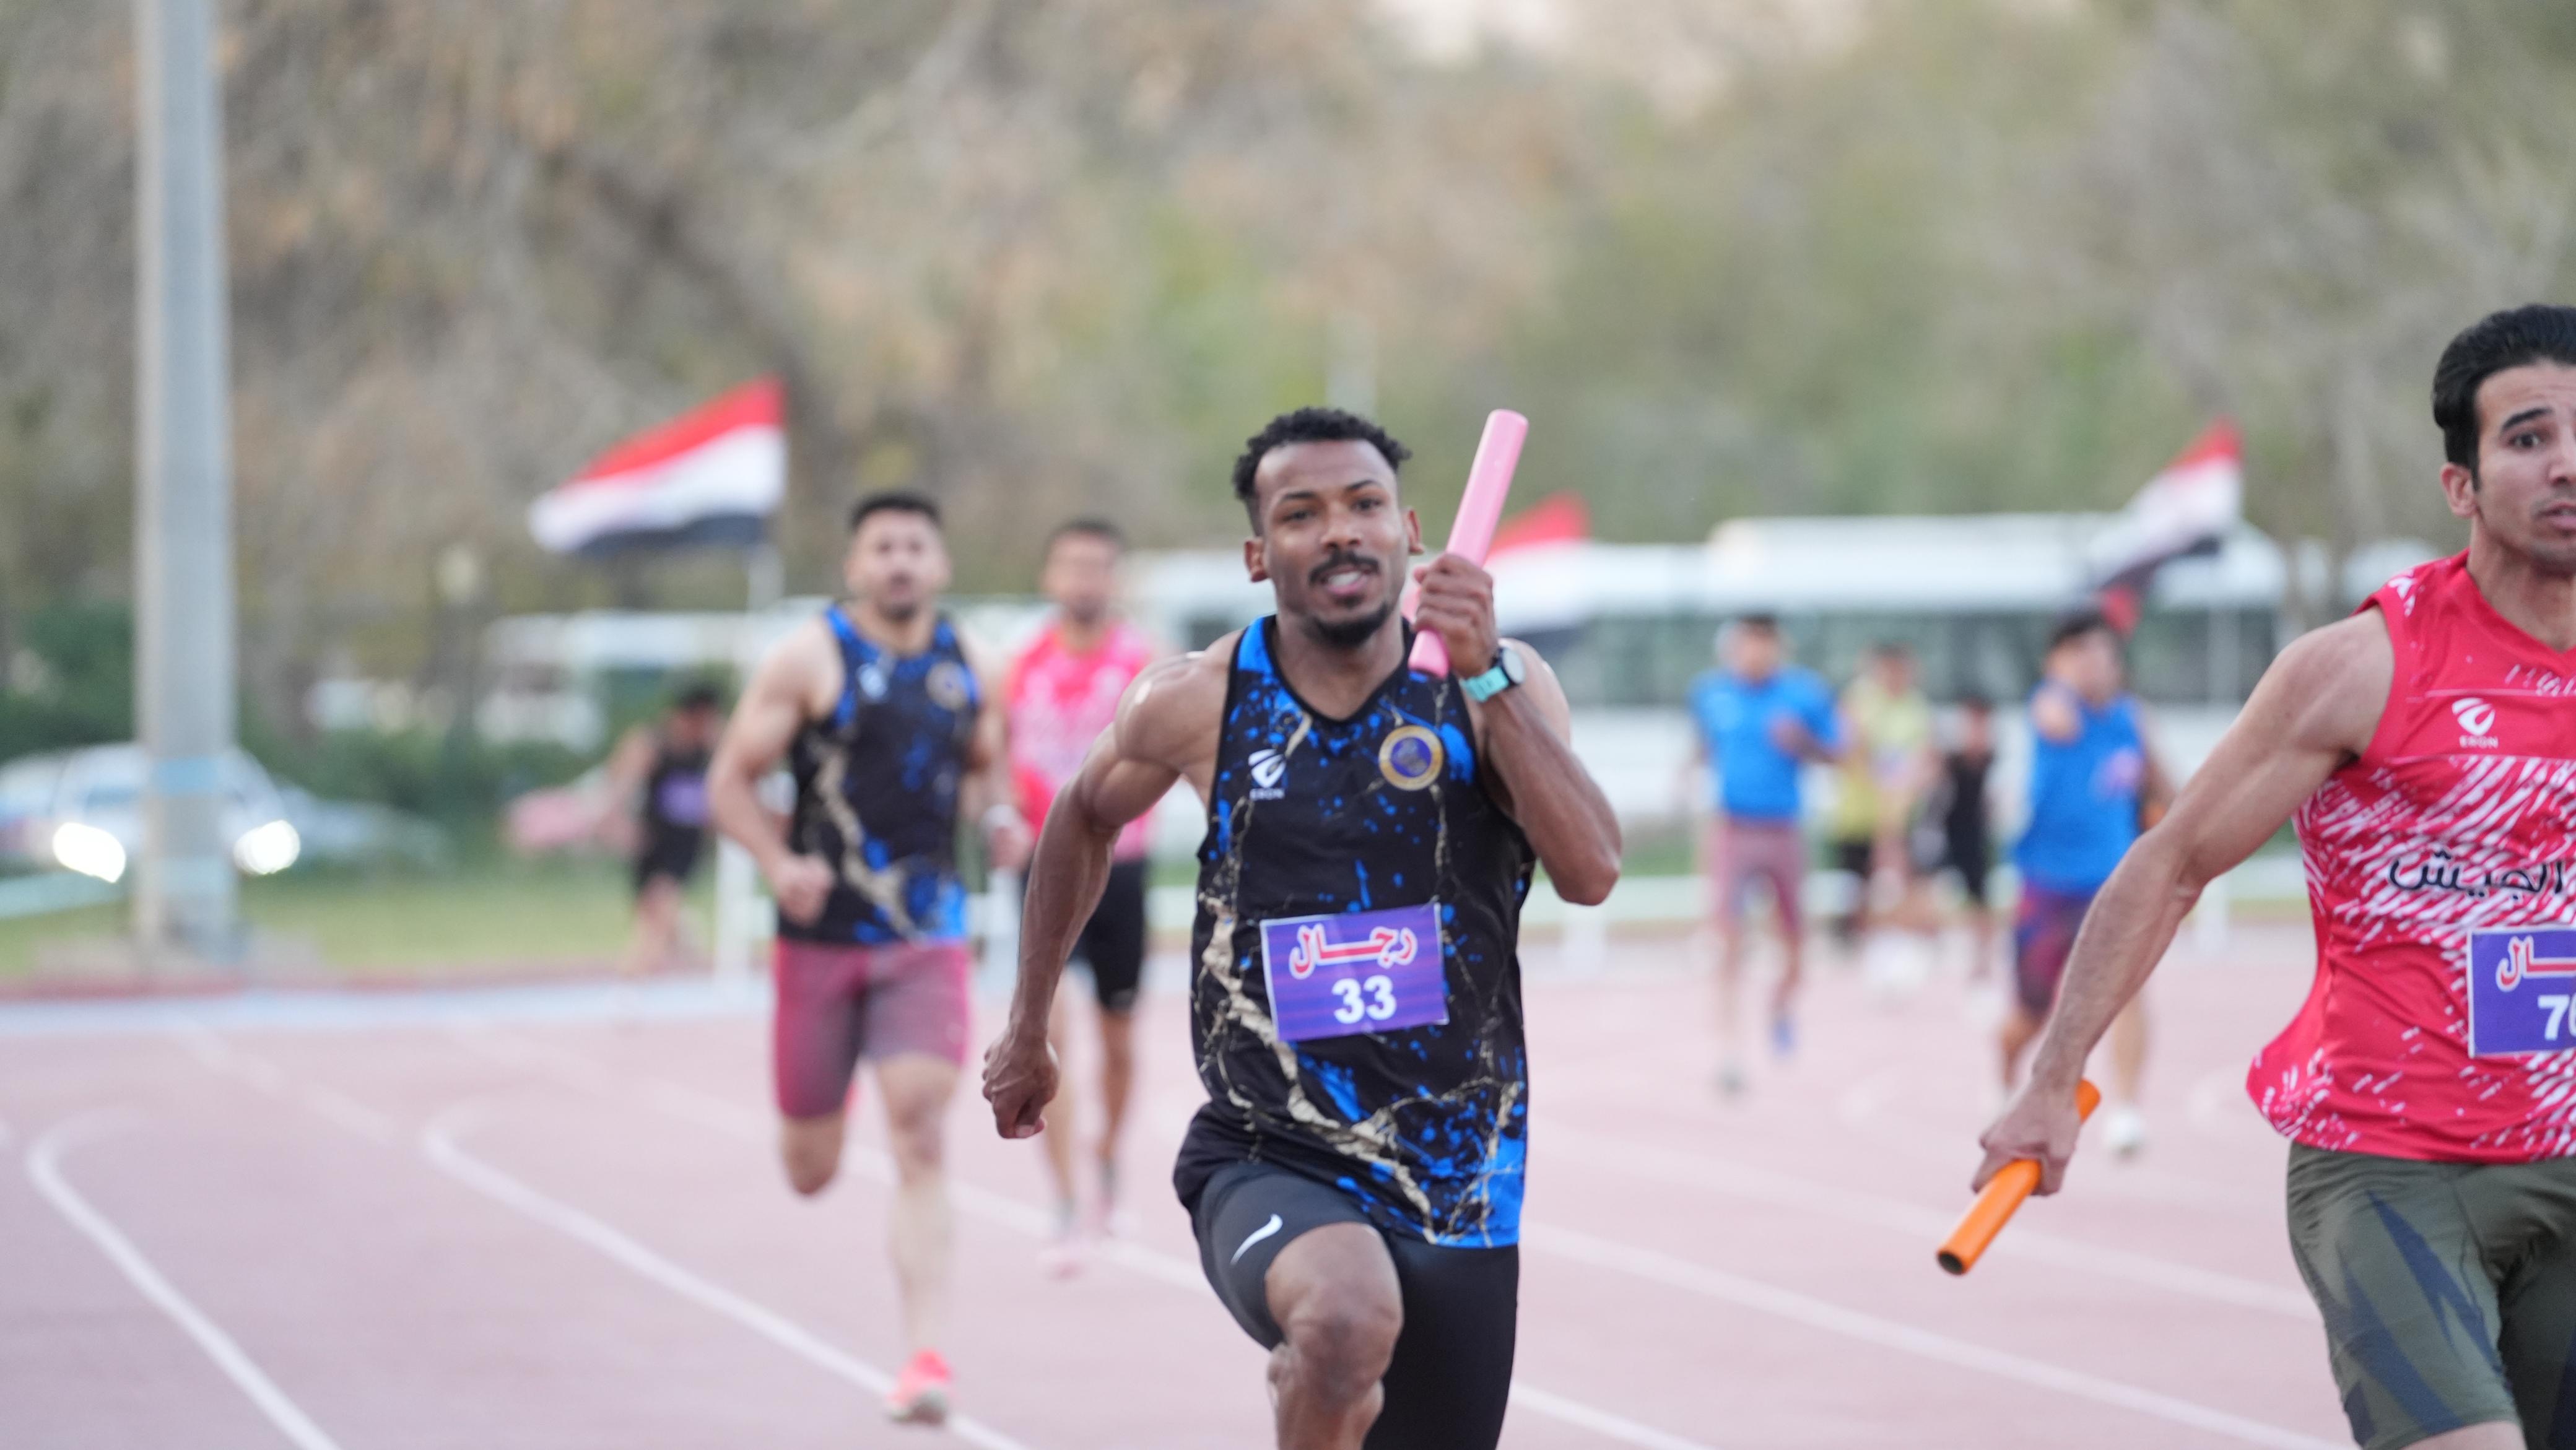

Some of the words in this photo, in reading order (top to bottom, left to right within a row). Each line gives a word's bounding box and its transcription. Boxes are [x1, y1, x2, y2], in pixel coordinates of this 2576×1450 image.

[2389, 850, 2563, 900] الجيش
[1289, 923, 1418, 979] رجال
[2496, 934, 2576, 993] ال
[1332, 975, 1398, 1024] 33
[2537, 992, 2576, 1042] 7
